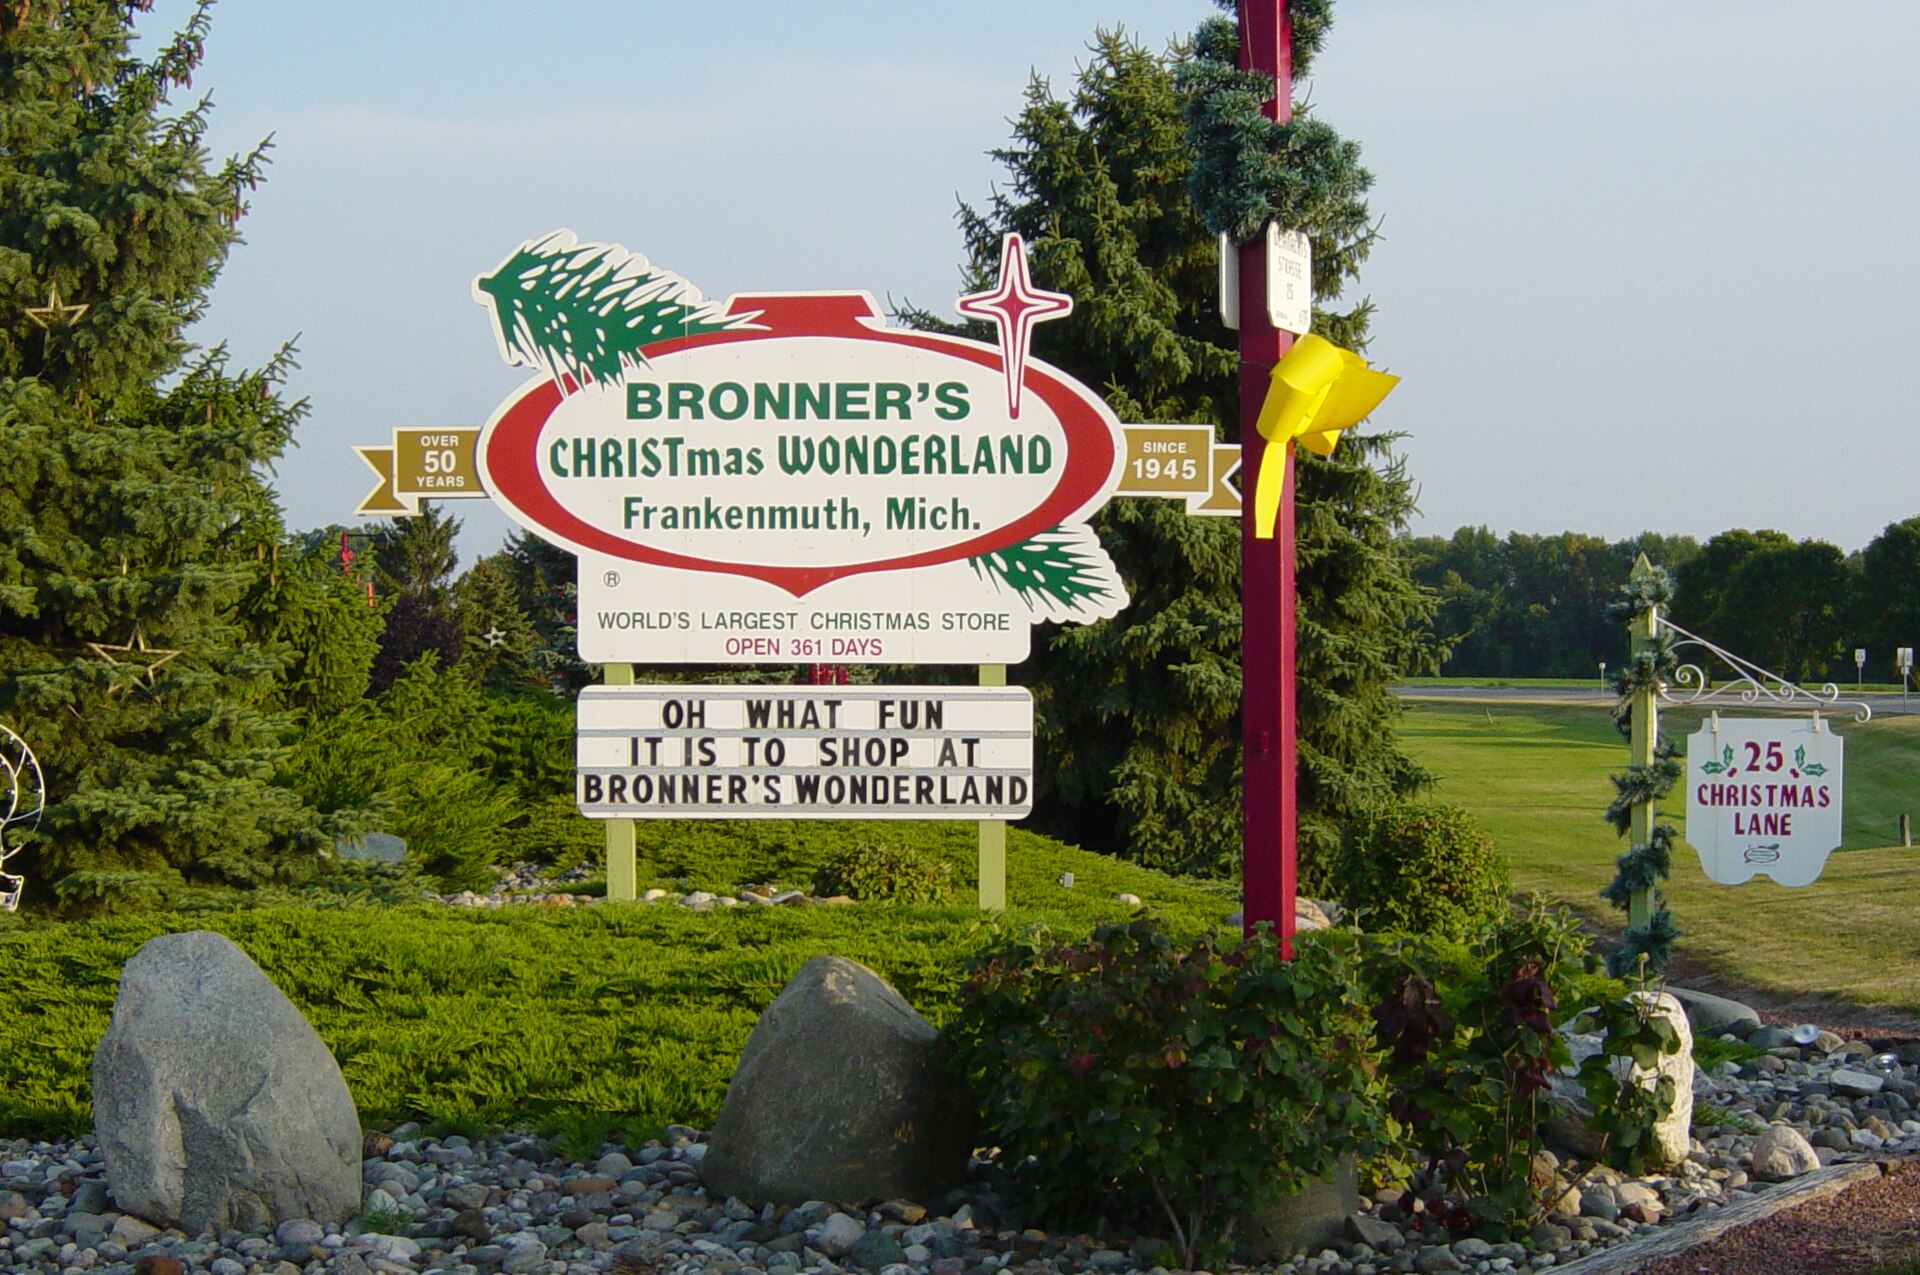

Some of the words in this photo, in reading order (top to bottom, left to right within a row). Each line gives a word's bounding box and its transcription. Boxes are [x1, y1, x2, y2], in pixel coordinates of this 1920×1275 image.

[625, 381, 970, 420] BRONNER'S
[421, 435, 458, 446] OVER
[1143, 442, 1186, 453] SINCE
[424, 450, 455, 472] 50
[550, 438, 764, 478] CHRISTmas
[779, 435, 1052, 476] WONDERLAND
[1133, 458, 1196, 479] 1945
[417, 476, 464, 487] YEARS
[622, 497, 872, 537] Frankenmuth,
[887, 497, 981, 531] Mich.
[598, 612, 690, 630] WORLD'S
[702, 612, 799, 630] LARGEST
[811, 612, 930, 631] CHRISTMAS
[942, 613, 1010, 631] STORE
[726, 638, 780, 656] OPEN
[791, 639, 821, 656] 361
[832, 639, 883, 656] DAYS
[663, 700, 705, 730] OH
[746, 700, 842, 730] WHAT
[879, 700, 943, 730] FUN
[631, 737, 663, 767] IT
[685, 737, 716, 767] IS
[743, 737, 786, 768] TO
[820, 738, 909, 768] SHOP
[938, 738, 980, 768] AT
[1745, 742, 1784, 772] 25
[585, 775, 781, 805] BRONNER'S
[796, 775, 1028, 806] WONDERLAND
[1698, 784, 1831, 808] CHRISTMAS
[1735, 813, 1792, 836] LANE
